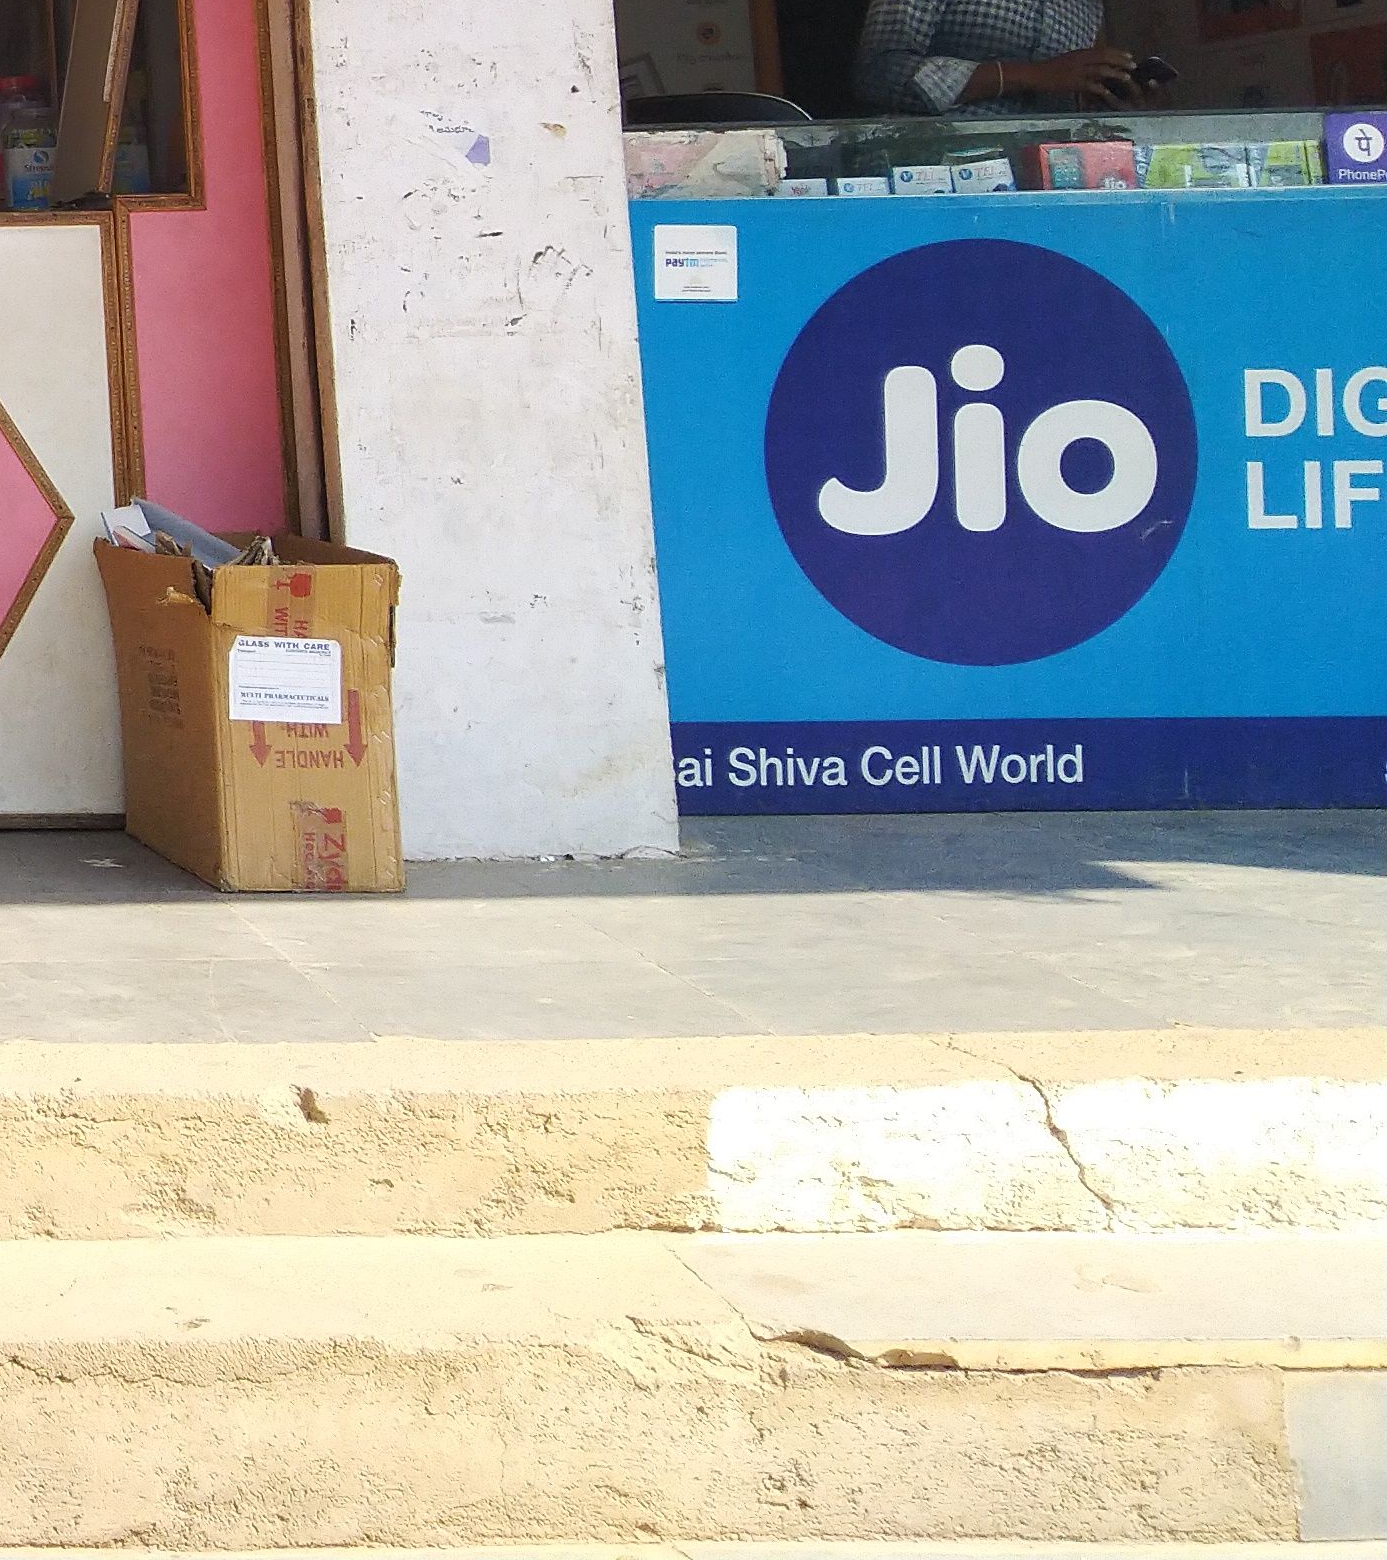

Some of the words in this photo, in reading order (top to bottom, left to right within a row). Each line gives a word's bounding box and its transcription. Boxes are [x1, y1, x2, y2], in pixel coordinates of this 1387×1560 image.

[818, 344, 1158, 536] Jio
[238, 639, 270, 648] GLASS
[274, 640, 300, 650] WITH
[303, 642, 330, 652] CARE
[275, 749, 344, 769] HANDLE
[672, 747, 713, 787] ai
[728, 746, 848, 787] Shiva
[860, 745, 941, 786] Cell
[955, 744, 1085, 785] World
